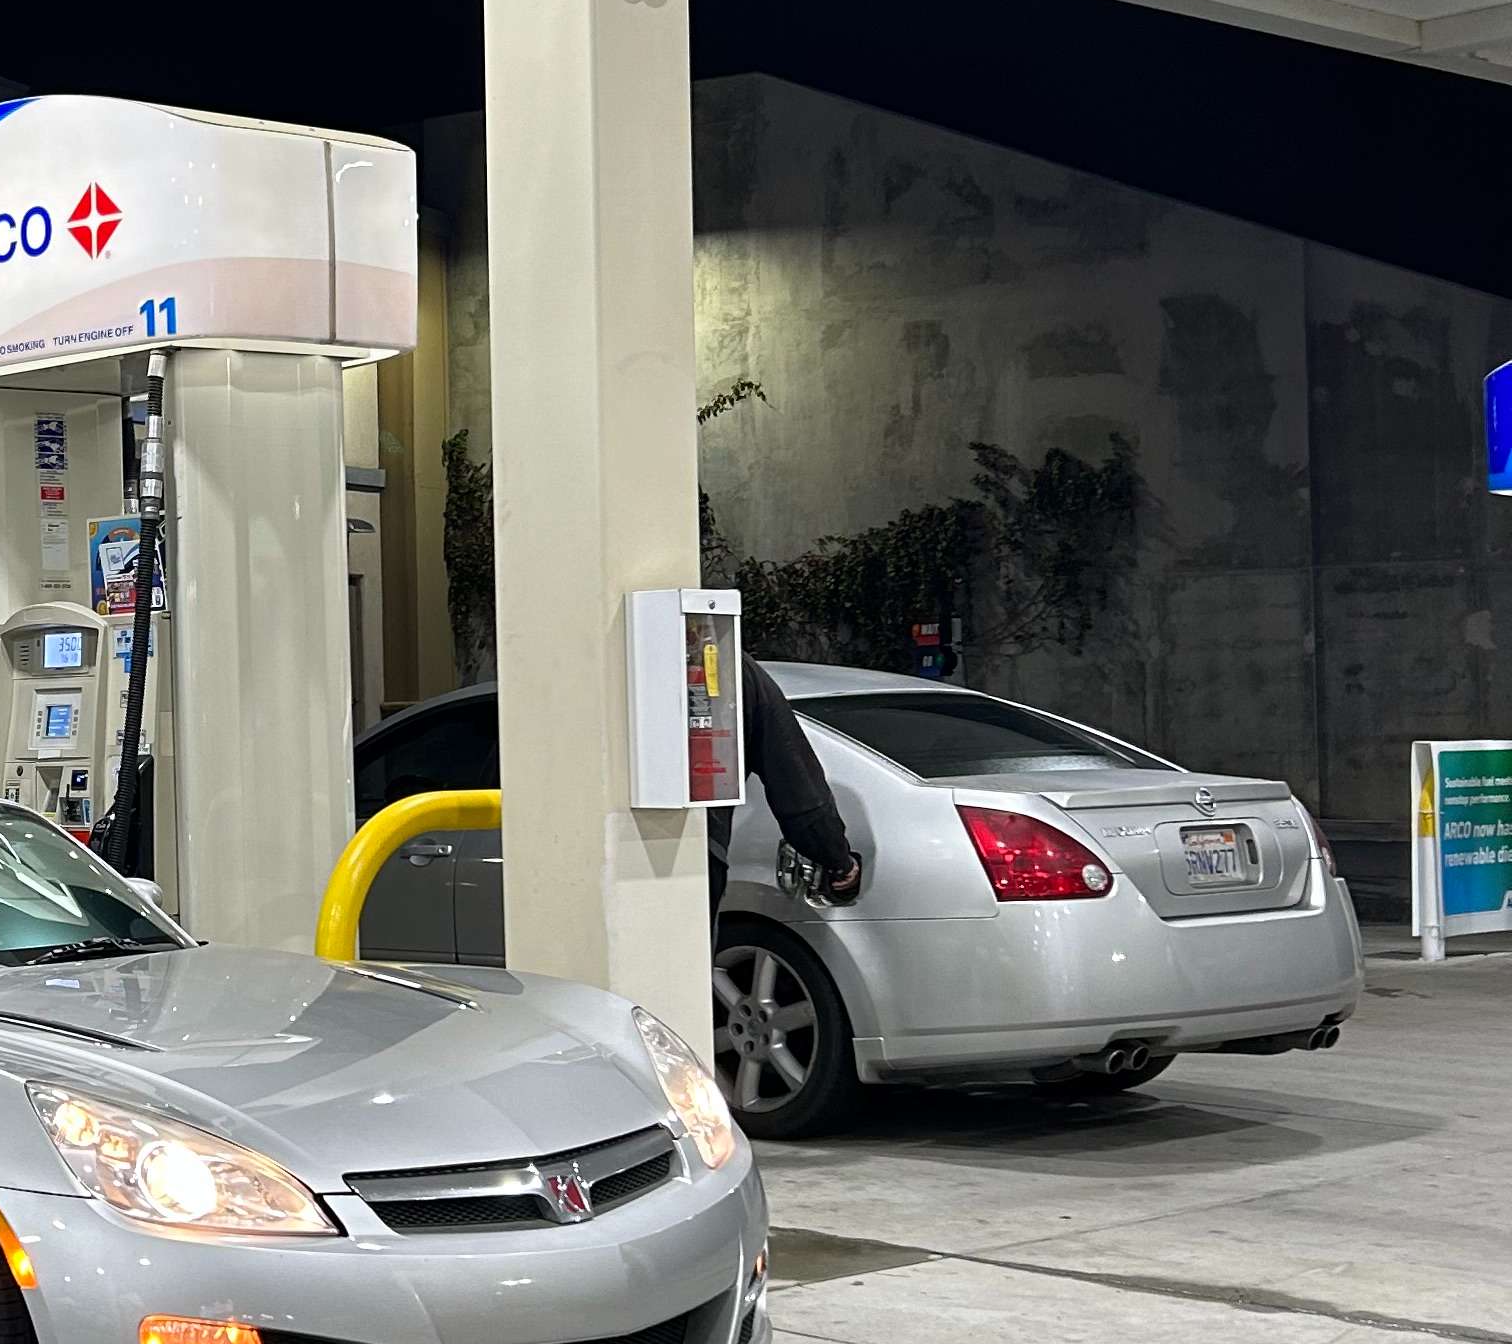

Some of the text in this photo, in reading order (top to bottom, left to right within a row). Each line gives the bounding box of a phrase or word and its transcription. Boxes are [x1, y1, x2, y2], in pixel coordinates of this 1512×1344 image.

[139, 297, 177, 337] 11
[7, 339, 45, 354] SMOKING
[53, 335, 77, 346] TURN
[78, 328, 113, 343] ENGINE
[115, 325, 134, 337] OFF
[1444, 821, 1472, 840] ARCO
[1473, 823, 1496, 838] now
[1444, 846, 1496, 867] renewable
